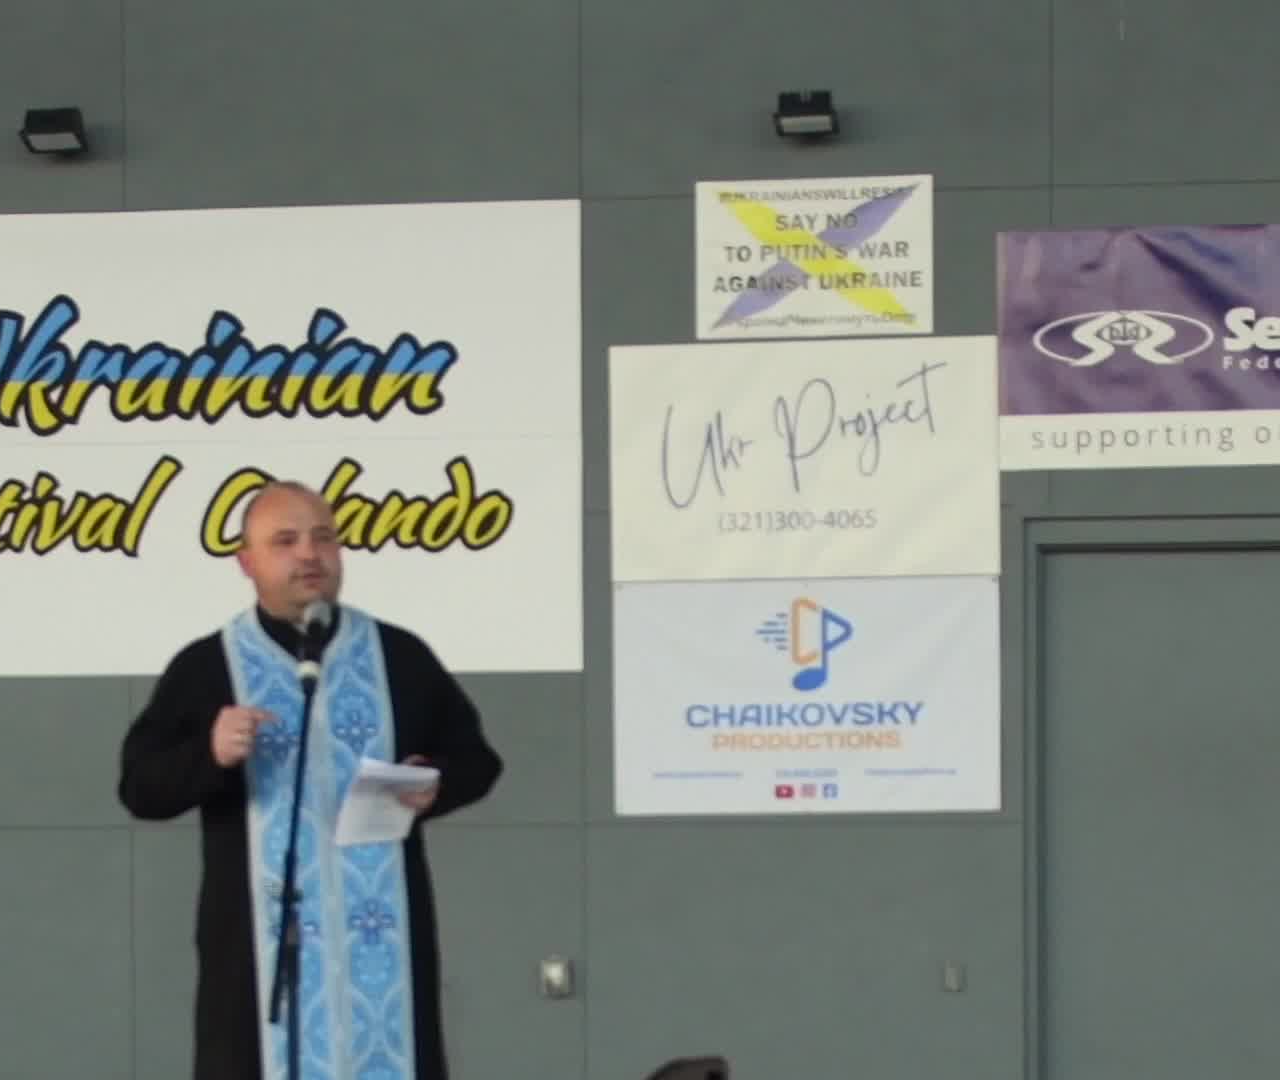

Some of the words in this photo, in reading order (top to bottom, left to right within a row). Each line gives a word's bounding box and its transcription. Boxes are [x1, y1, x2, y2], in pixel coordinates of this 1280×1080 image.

[775, 213, 818, 232] SAY
[826, 212, 858, 230] NO
[723, 245, 753, 263] TO
[859, 240, 910, 260] WAR
[713, 273, 811, 293] AGAINST
[819, 270, 924, 291] UKRAINE
[774, 361, 948, 493] Project
[1031, 422, 1235, 456] supporting
[201, 456, 513, 557] Olando
[685, 701, 925, 728] CHAIKOVSKY
[711, 731, 901, 751] PRODUCTIONS
